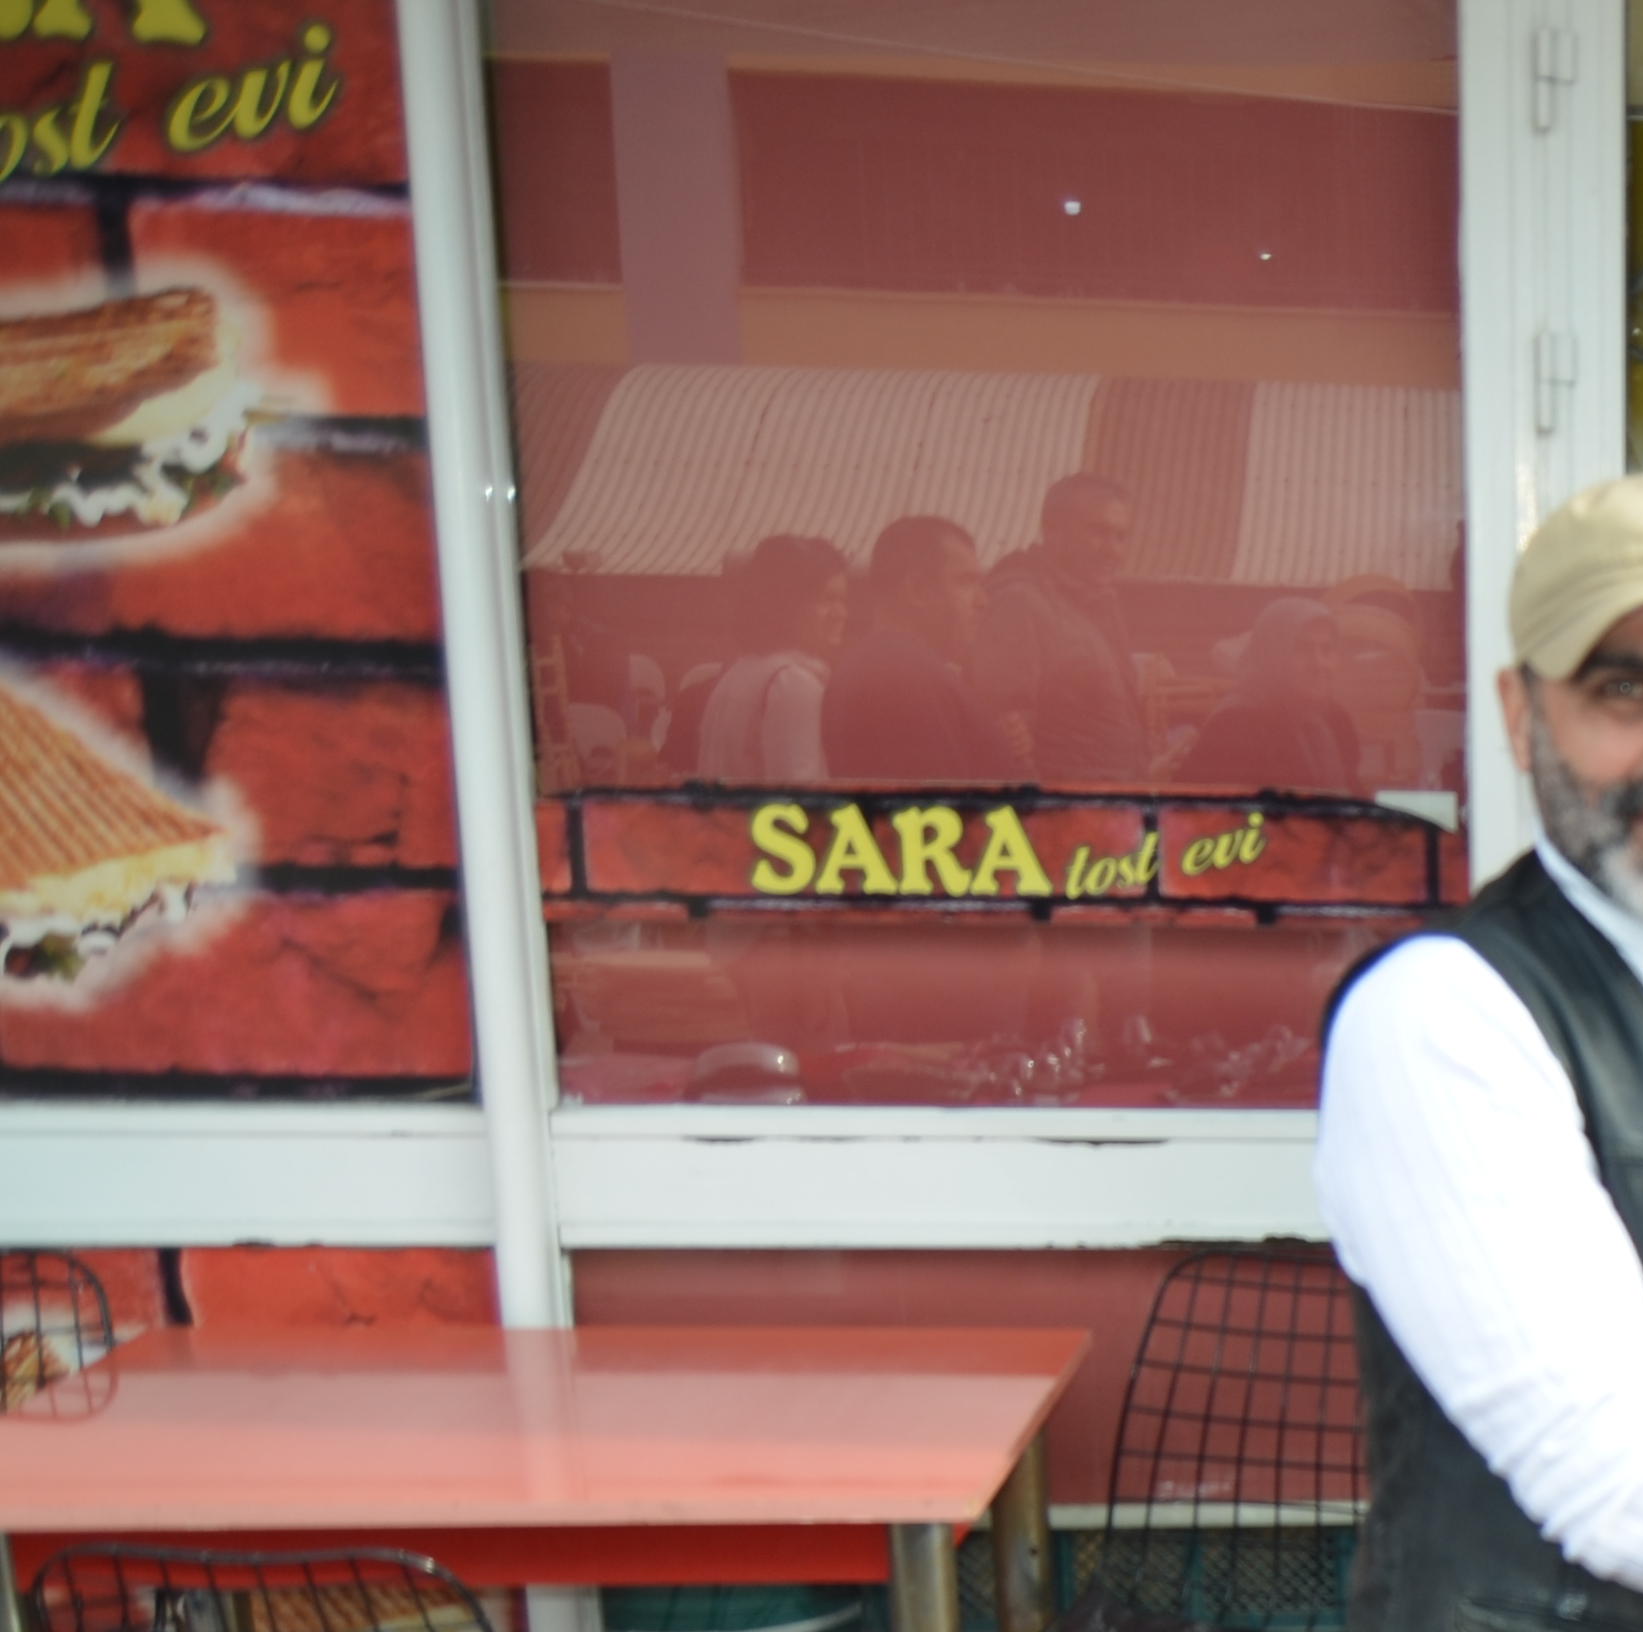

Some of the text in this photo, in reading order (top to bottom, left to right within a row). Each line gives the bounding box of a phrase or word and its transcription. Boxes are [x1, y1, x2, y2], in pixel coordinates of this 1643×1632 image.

[168, 24, 338, 152] evi
[752, 803, 1265, 899] SARA tost evi
